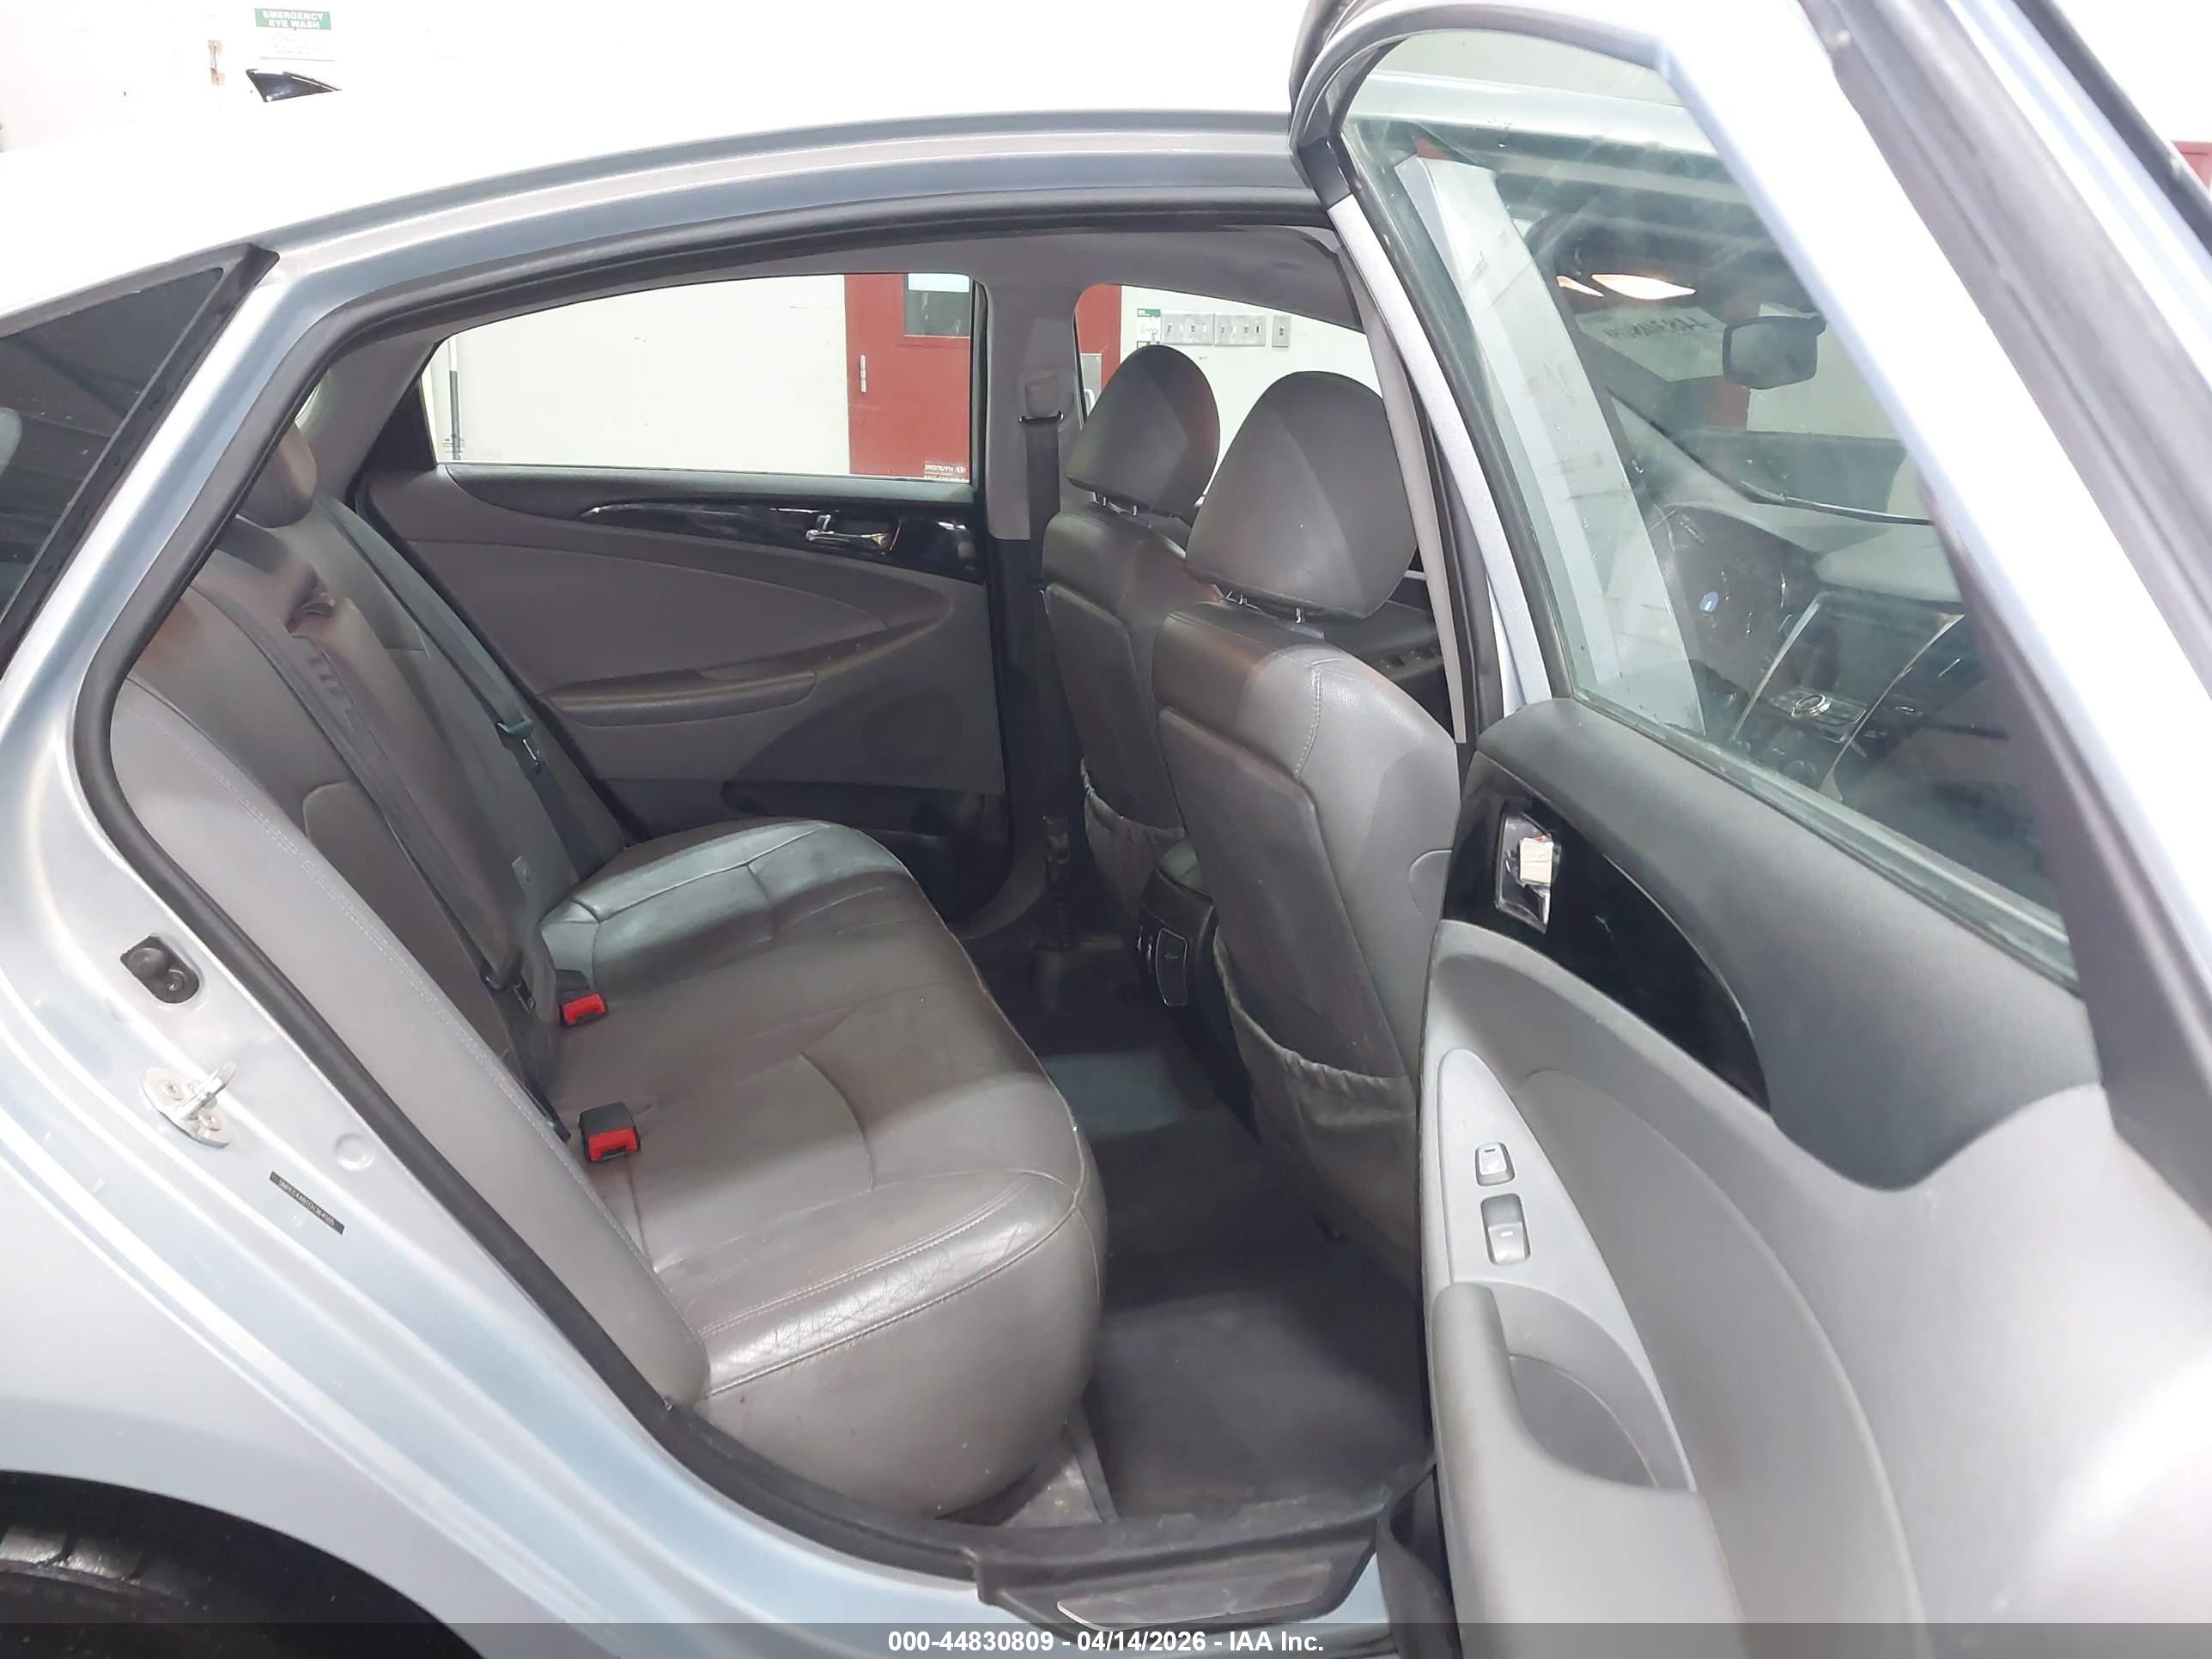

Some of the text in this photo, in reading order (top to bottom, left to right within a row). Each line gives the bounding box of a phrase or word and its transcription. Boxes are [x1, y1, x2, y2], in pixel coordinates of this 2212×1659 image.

[262, 9, 324, 21] EMERGENCY
[268, 19, 320, 28] EYE WASH
